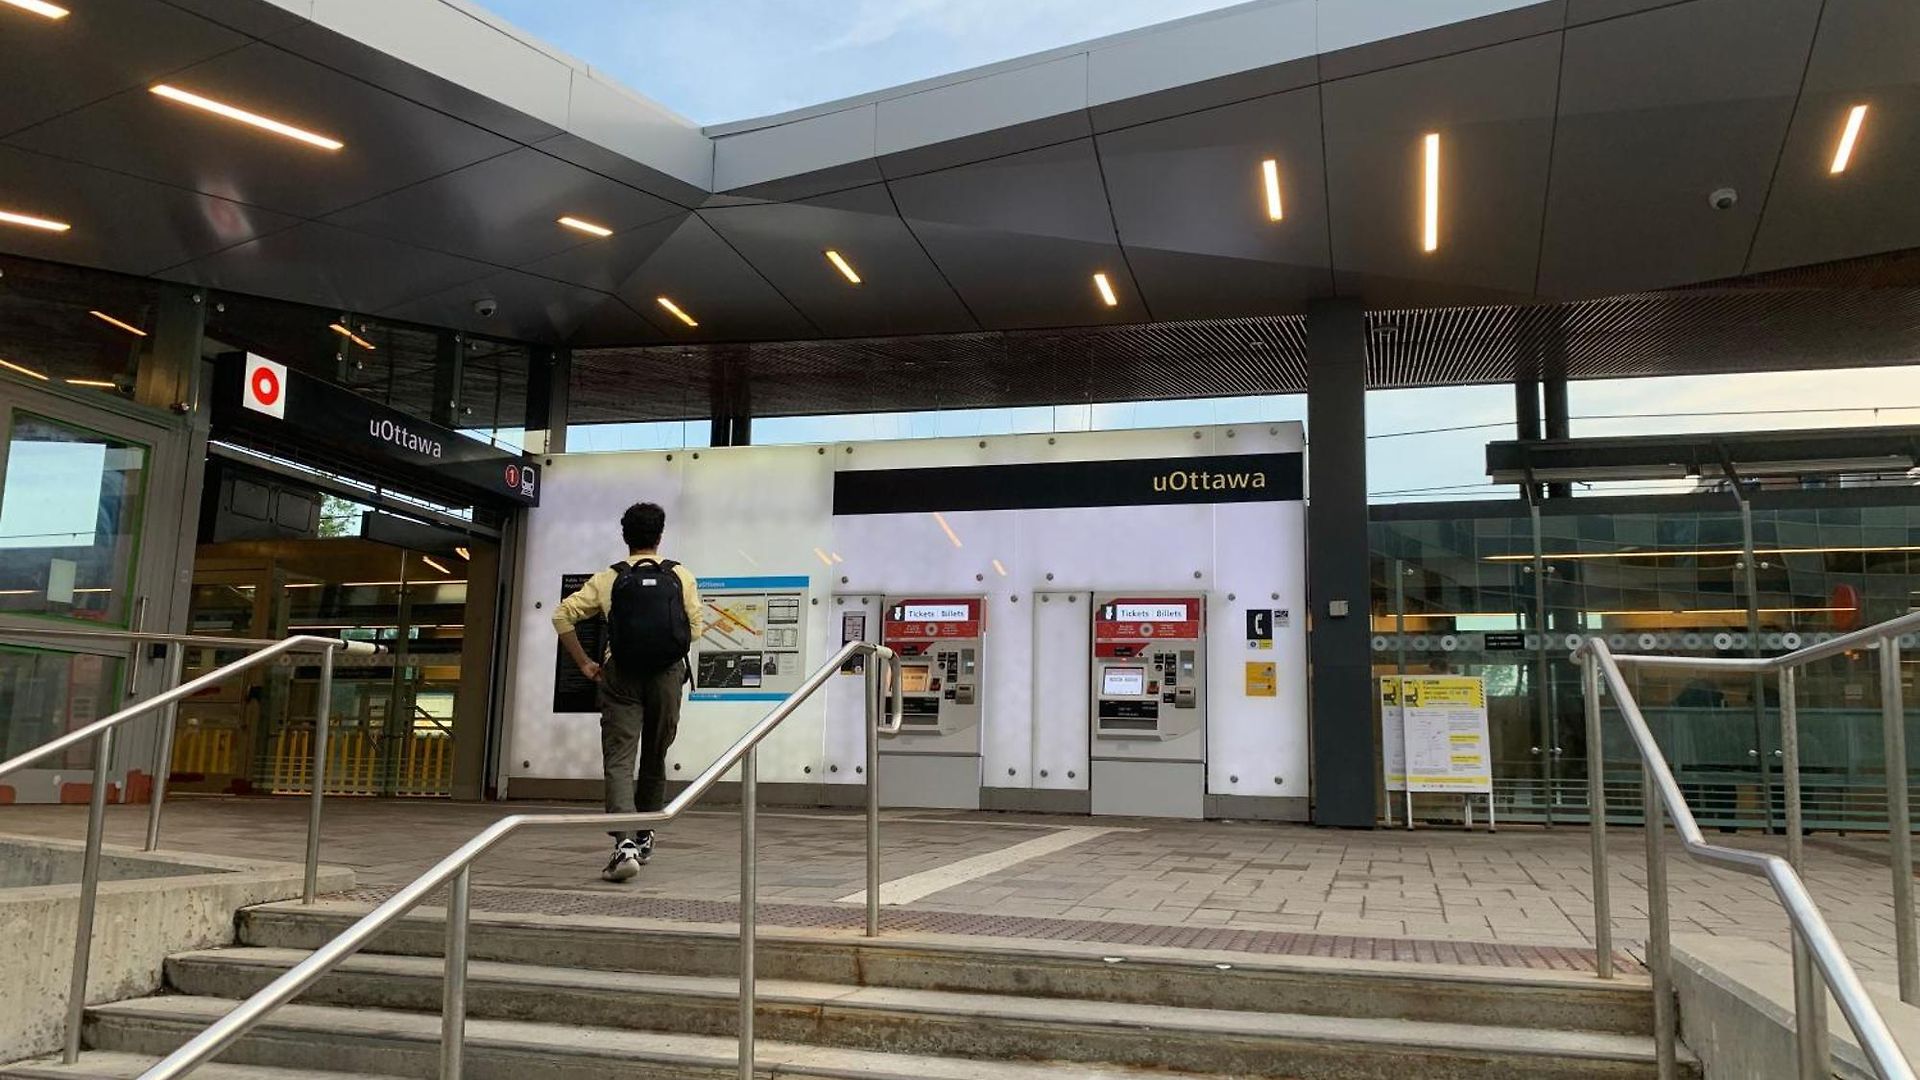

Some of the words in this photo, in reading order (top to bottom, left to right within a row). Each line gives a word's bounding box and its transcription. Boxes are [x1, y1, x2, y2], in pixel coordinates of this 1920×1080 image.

[370, 419, 442, 458] uOttawa
[1153, 471, 1266, 491] uOttawa
[1121, 609, 1149, 617] Tickets
[1156, 609, 1182, 617] Billets
